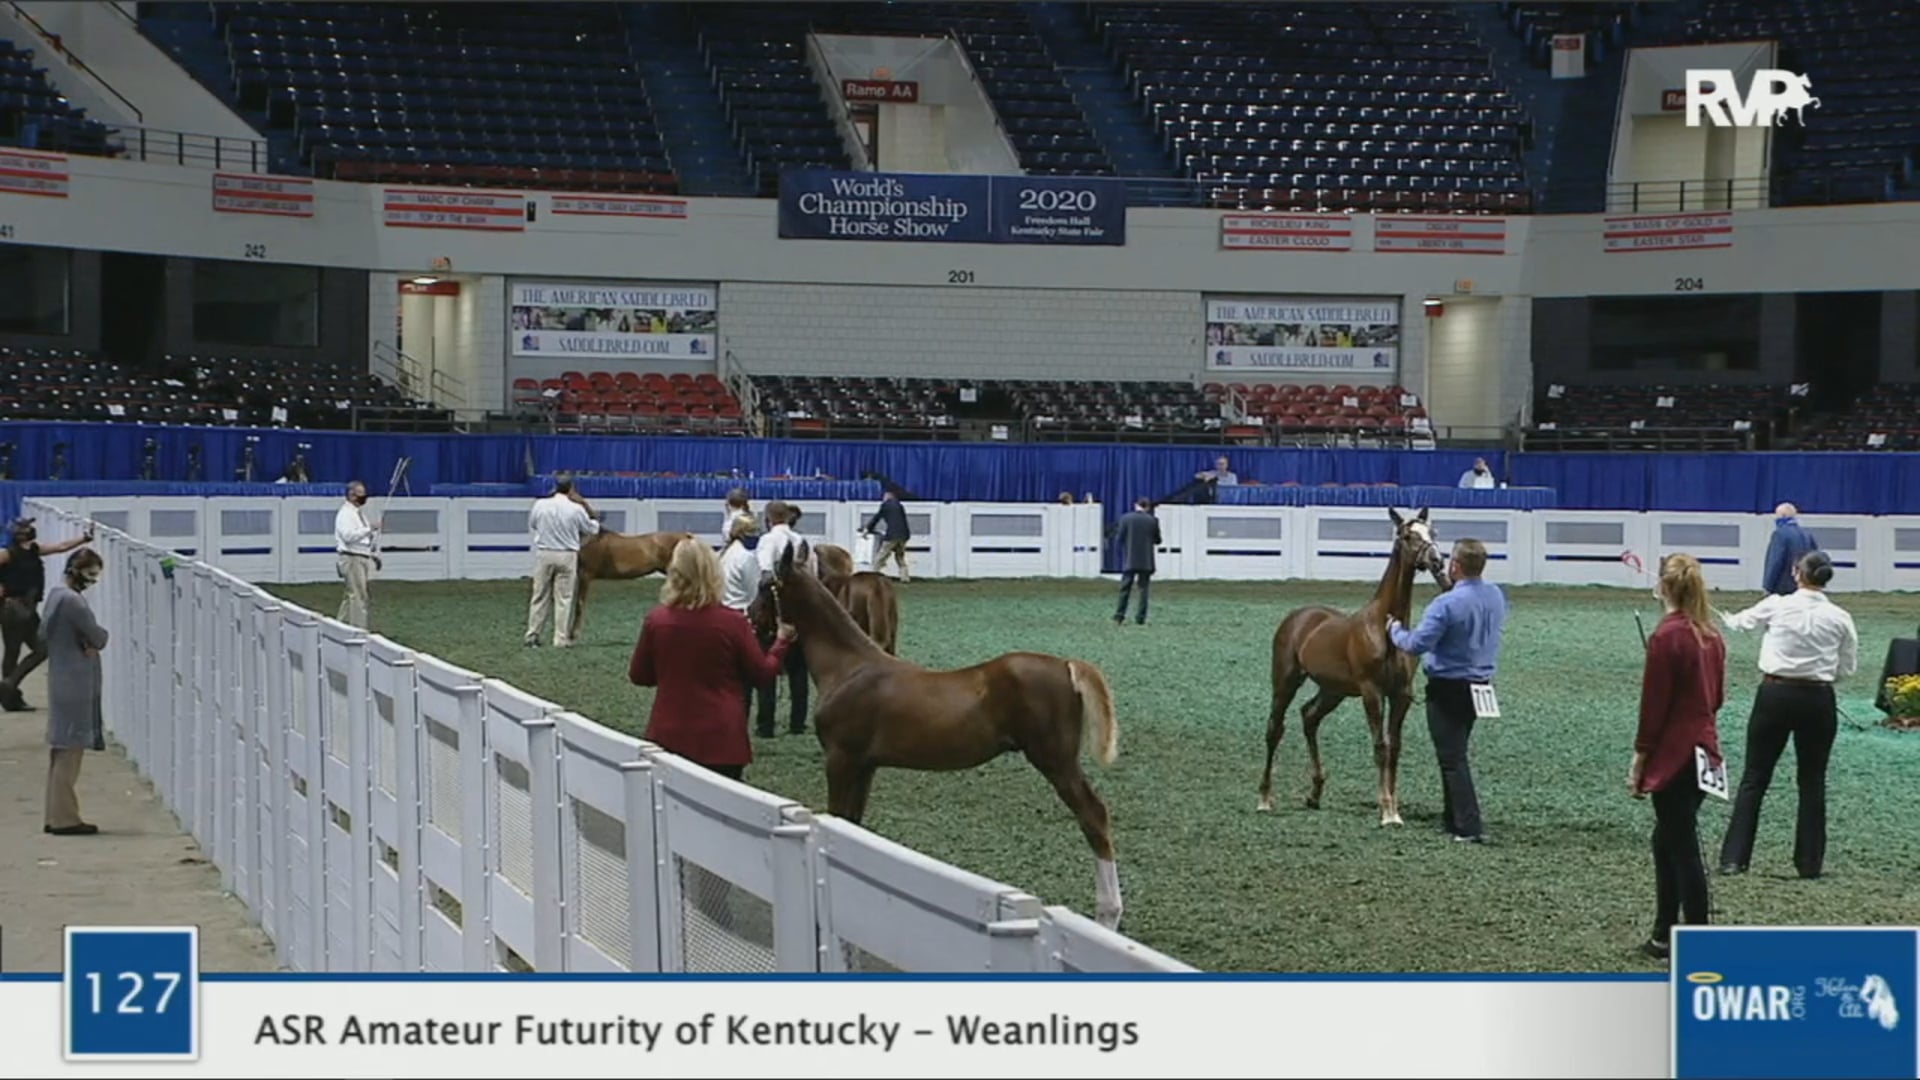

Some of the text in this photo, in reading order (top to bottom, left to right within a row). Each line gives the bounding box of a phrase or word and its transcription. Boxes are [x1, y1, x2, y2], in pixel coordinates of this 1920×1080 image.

[847, 83, 912, 97] Ramp AA
[831, 178, 904, 197] World's
[1019, 189, 1097, 211] 2020
[800, 193, 968, 222] Championship
[830, 217, 948, 237] Horse Show
[1025, 215, 1091, 225] Freedom Hall
[1011, 226, 1104, 237] Kentucky State Fair
[1249, 236, 1290, 244] EASTER
[245, 243, 266, 258] 242
[949, 270, 975, 283] 201
[1675, 277, 1703, 291] 204
[522, 288, 708, 306] THE AMERICAN SADDLEBRED
[1216, 307, 1391, 321] THE AMERICAN SADDLEBRED
[1474, 688, 1495, 712] 717
